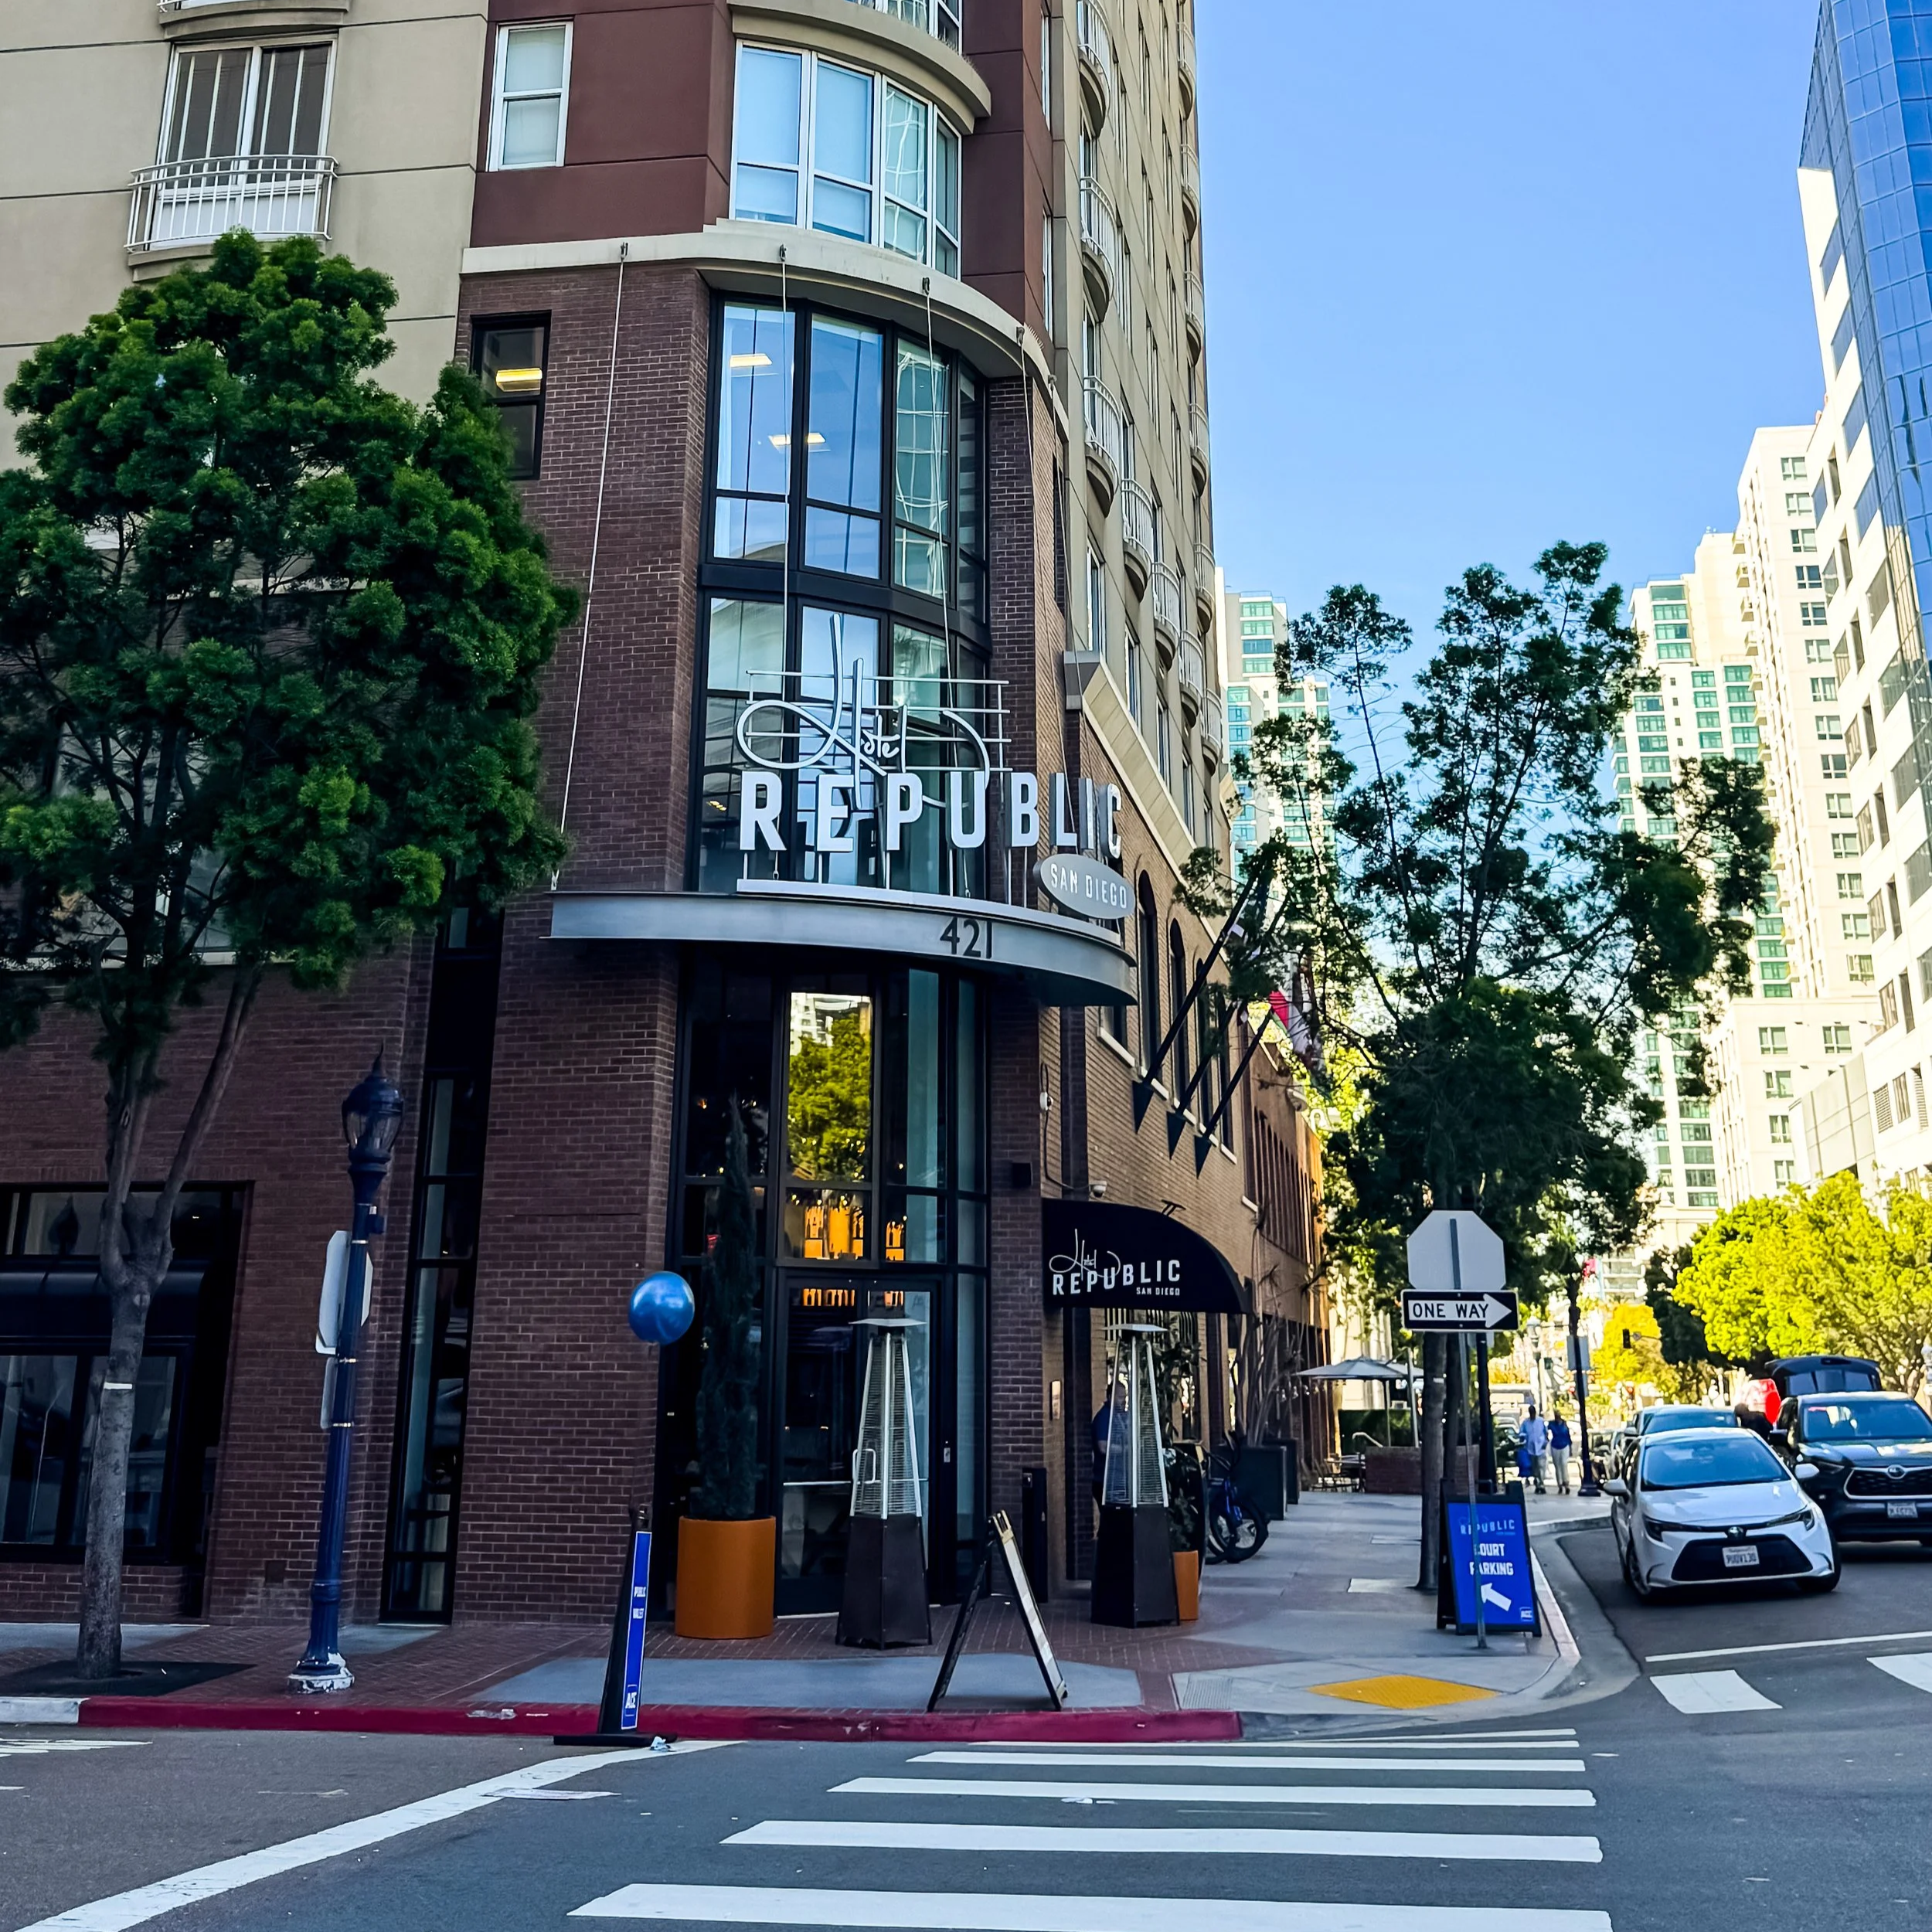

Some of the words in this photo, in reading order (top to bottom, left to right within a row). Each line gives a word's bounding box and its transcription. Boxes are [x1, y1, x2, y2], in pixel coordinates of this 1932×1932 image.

[740, 771, 1121, 859] REPUBLIC
[1050, 863, 1078, 893] SAN
[1086, 875, 1127, 909] DIEGO
[940, 917, 992, 958] 421
[1053, 1260, 1180, 1295] REPUBLIC
[1136, 1287, 1151, 1295] SAN
[1155, 1287, 1180, 1296] DIEGO
[1413, 1303, 1446, 1318] ONE
[1456, 1303, 1488, 1318] WAY
